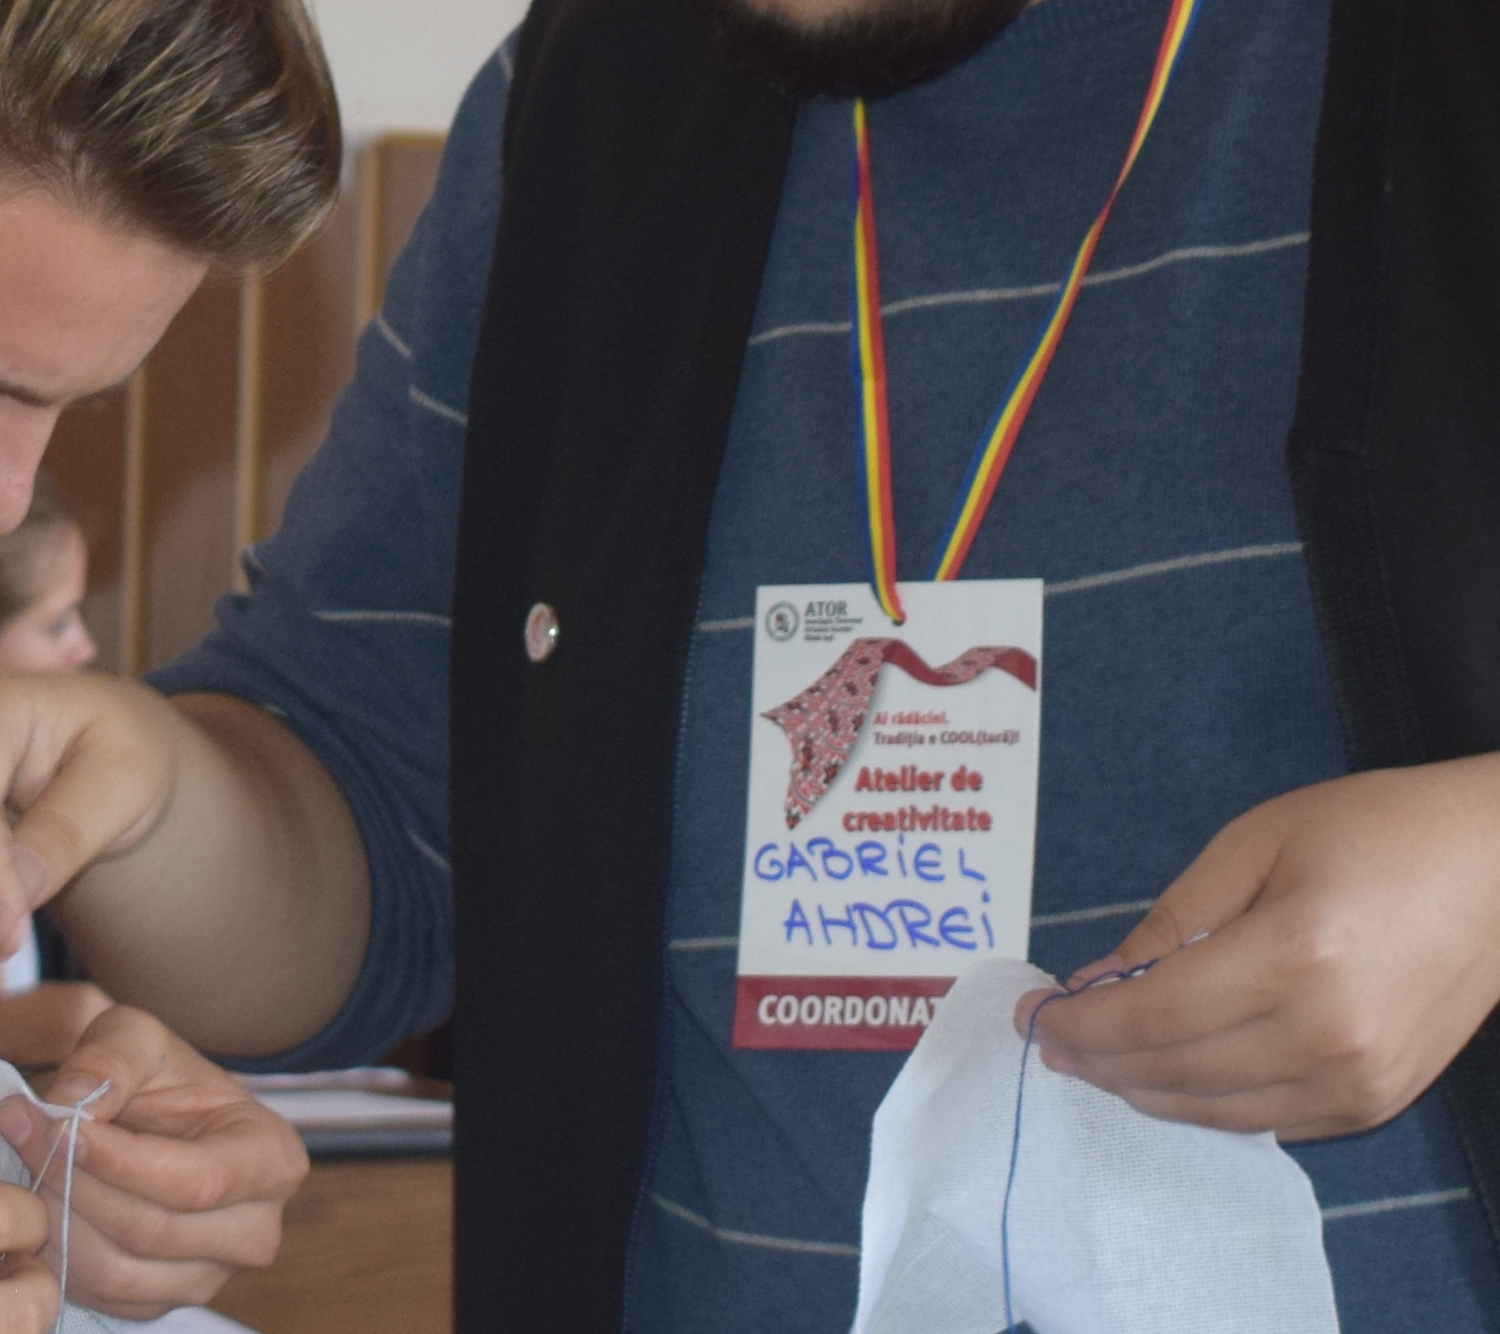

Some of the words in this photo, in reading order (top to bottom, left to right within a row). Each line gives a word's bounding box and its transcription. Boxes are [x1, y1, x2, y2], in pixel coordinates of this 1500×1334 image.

[805, 600, 847, 616] ATOR
[929, 734, 936, 744] e
[855, 764, 945, 792] Atelier
[950, 764, 983, 791] de
[842, 805, 993, 832] creativitate
